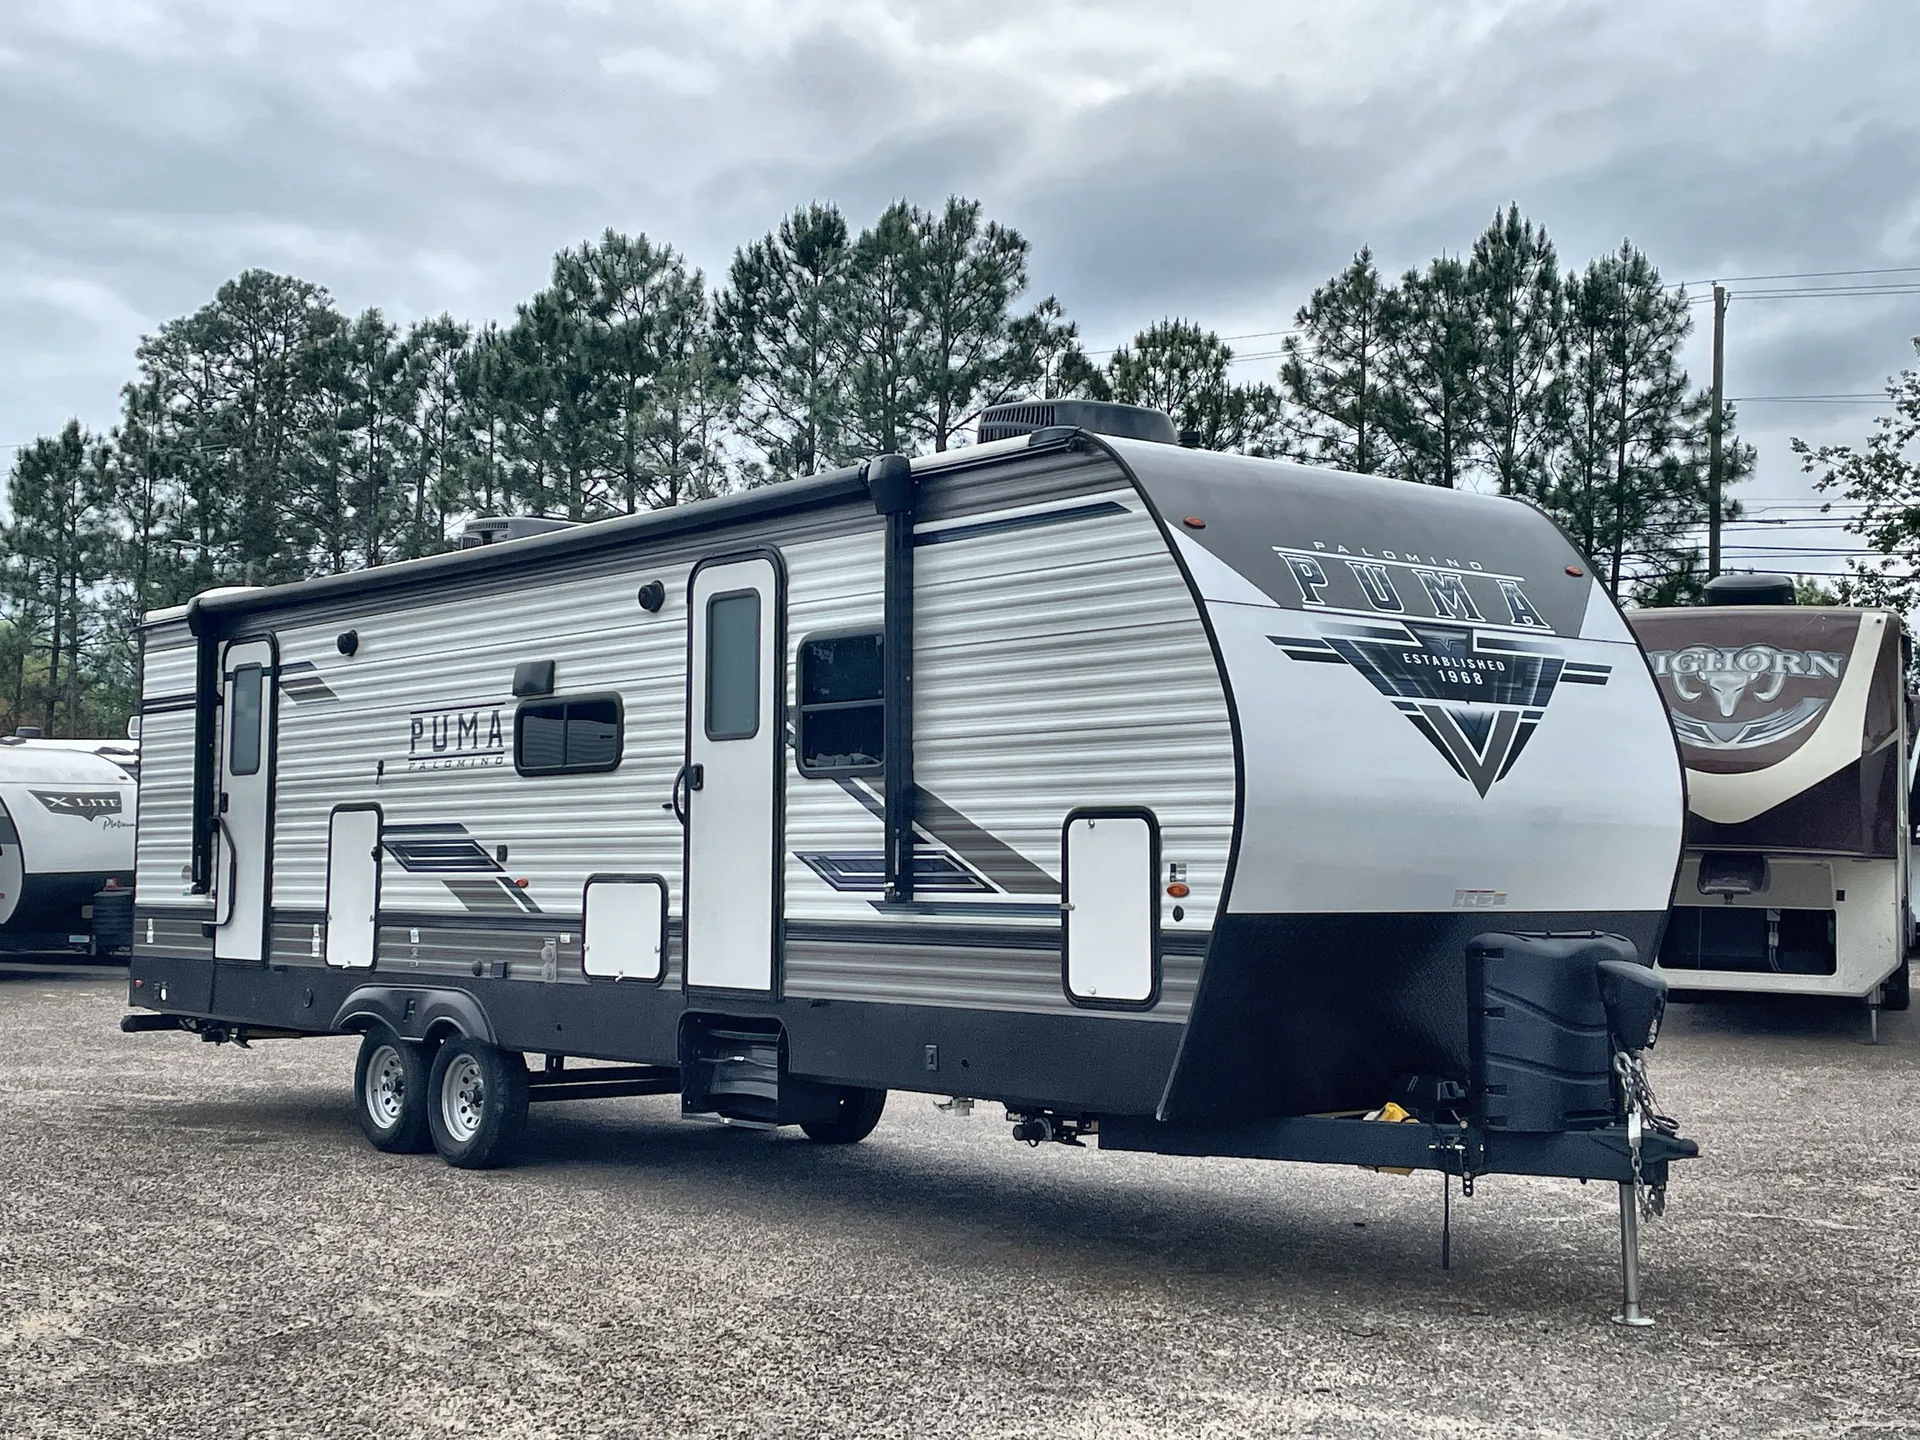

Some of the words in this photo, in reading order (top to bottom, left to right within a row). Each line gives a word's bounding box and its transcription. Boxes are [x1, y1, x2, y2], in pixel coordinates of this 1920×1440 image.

[1312, 541, 1484, 571] PALOMINO
[1278, 553, 1551, 629] PUMA
[1402, 652, 1506, 672] ESTABLISHED
[1647, 649, 1844, 678] IGHORN
[1438, 669, 1484, 686] 1968
[409, 709, 504, 754] PUMA
[409, 756, 504, 771] PALOMINO
[75, 798, 121, 807] LITE
